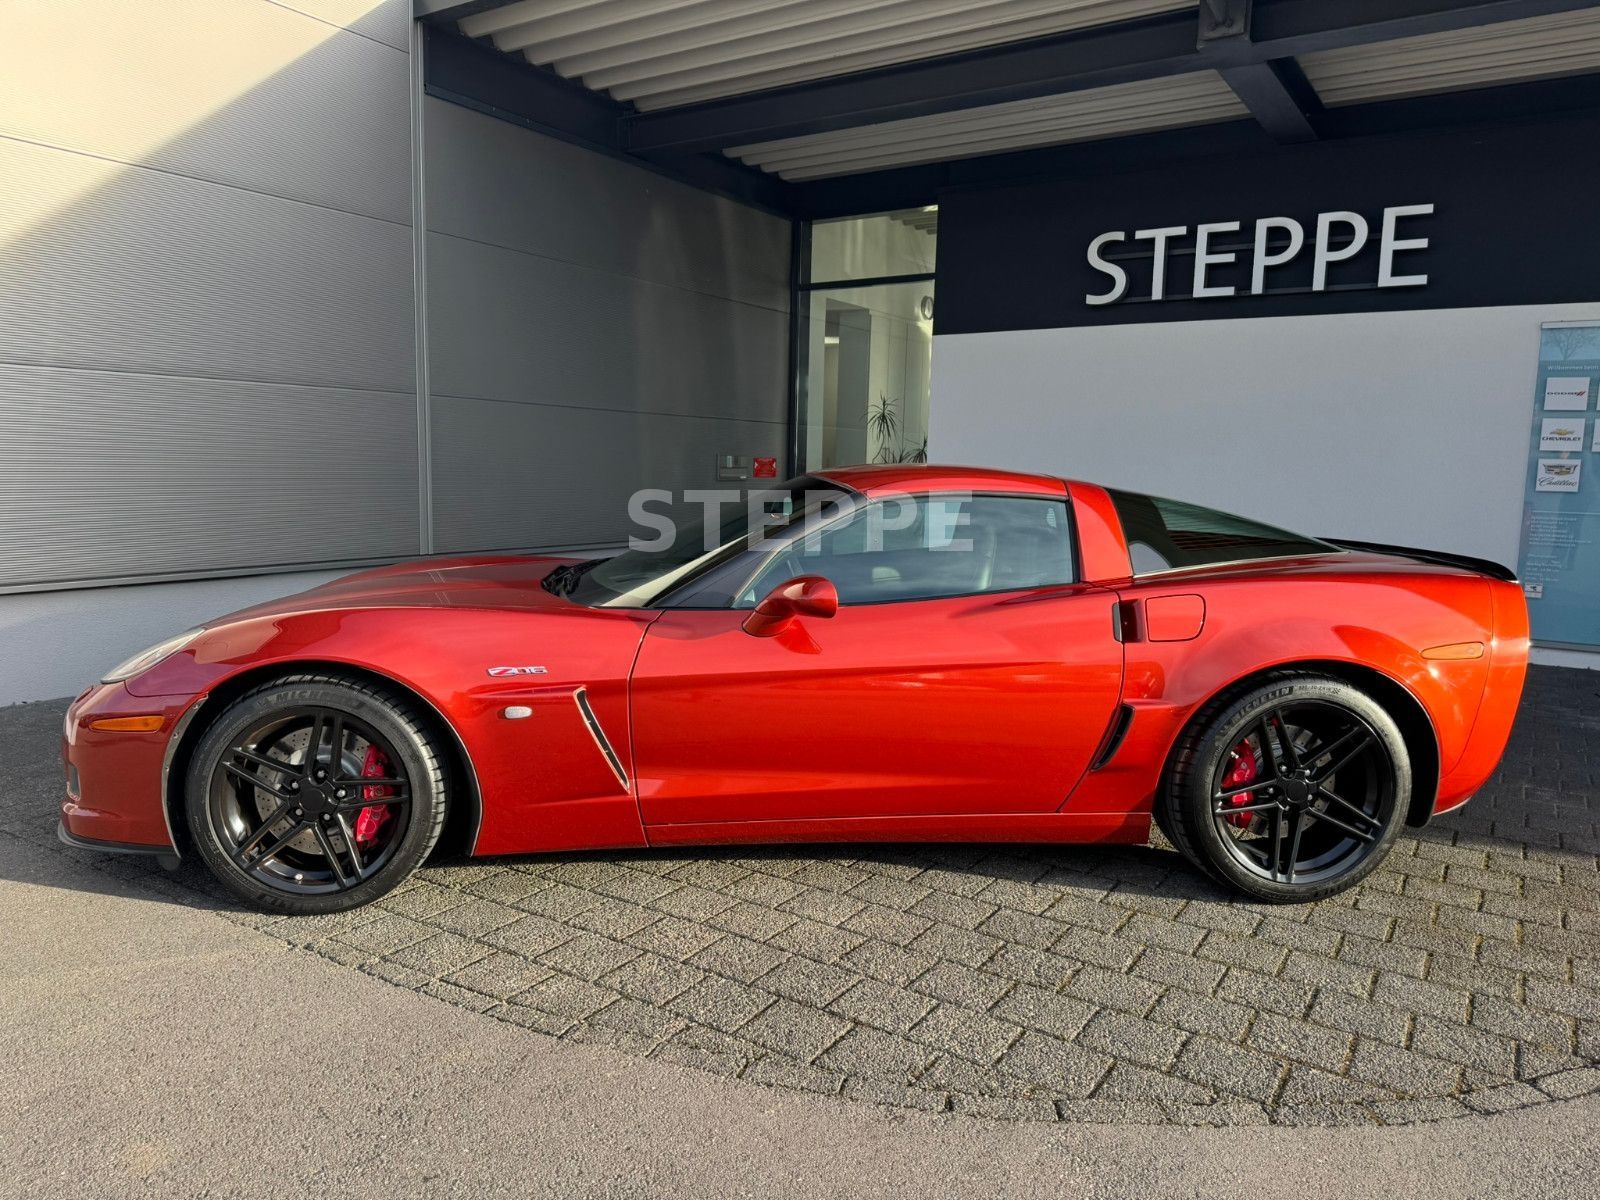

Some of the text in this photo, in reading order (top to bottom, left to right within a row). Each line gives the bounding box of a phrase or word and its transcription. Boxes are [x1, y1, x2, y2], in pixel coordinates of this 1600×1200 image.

[1085, 203, 1434, 305] STEPPE
[1538, 476, 1577, 488] Cadillac
[487, 666, 549, 677] Z06
[1231, 687, 1290, 724] MICHELIN
